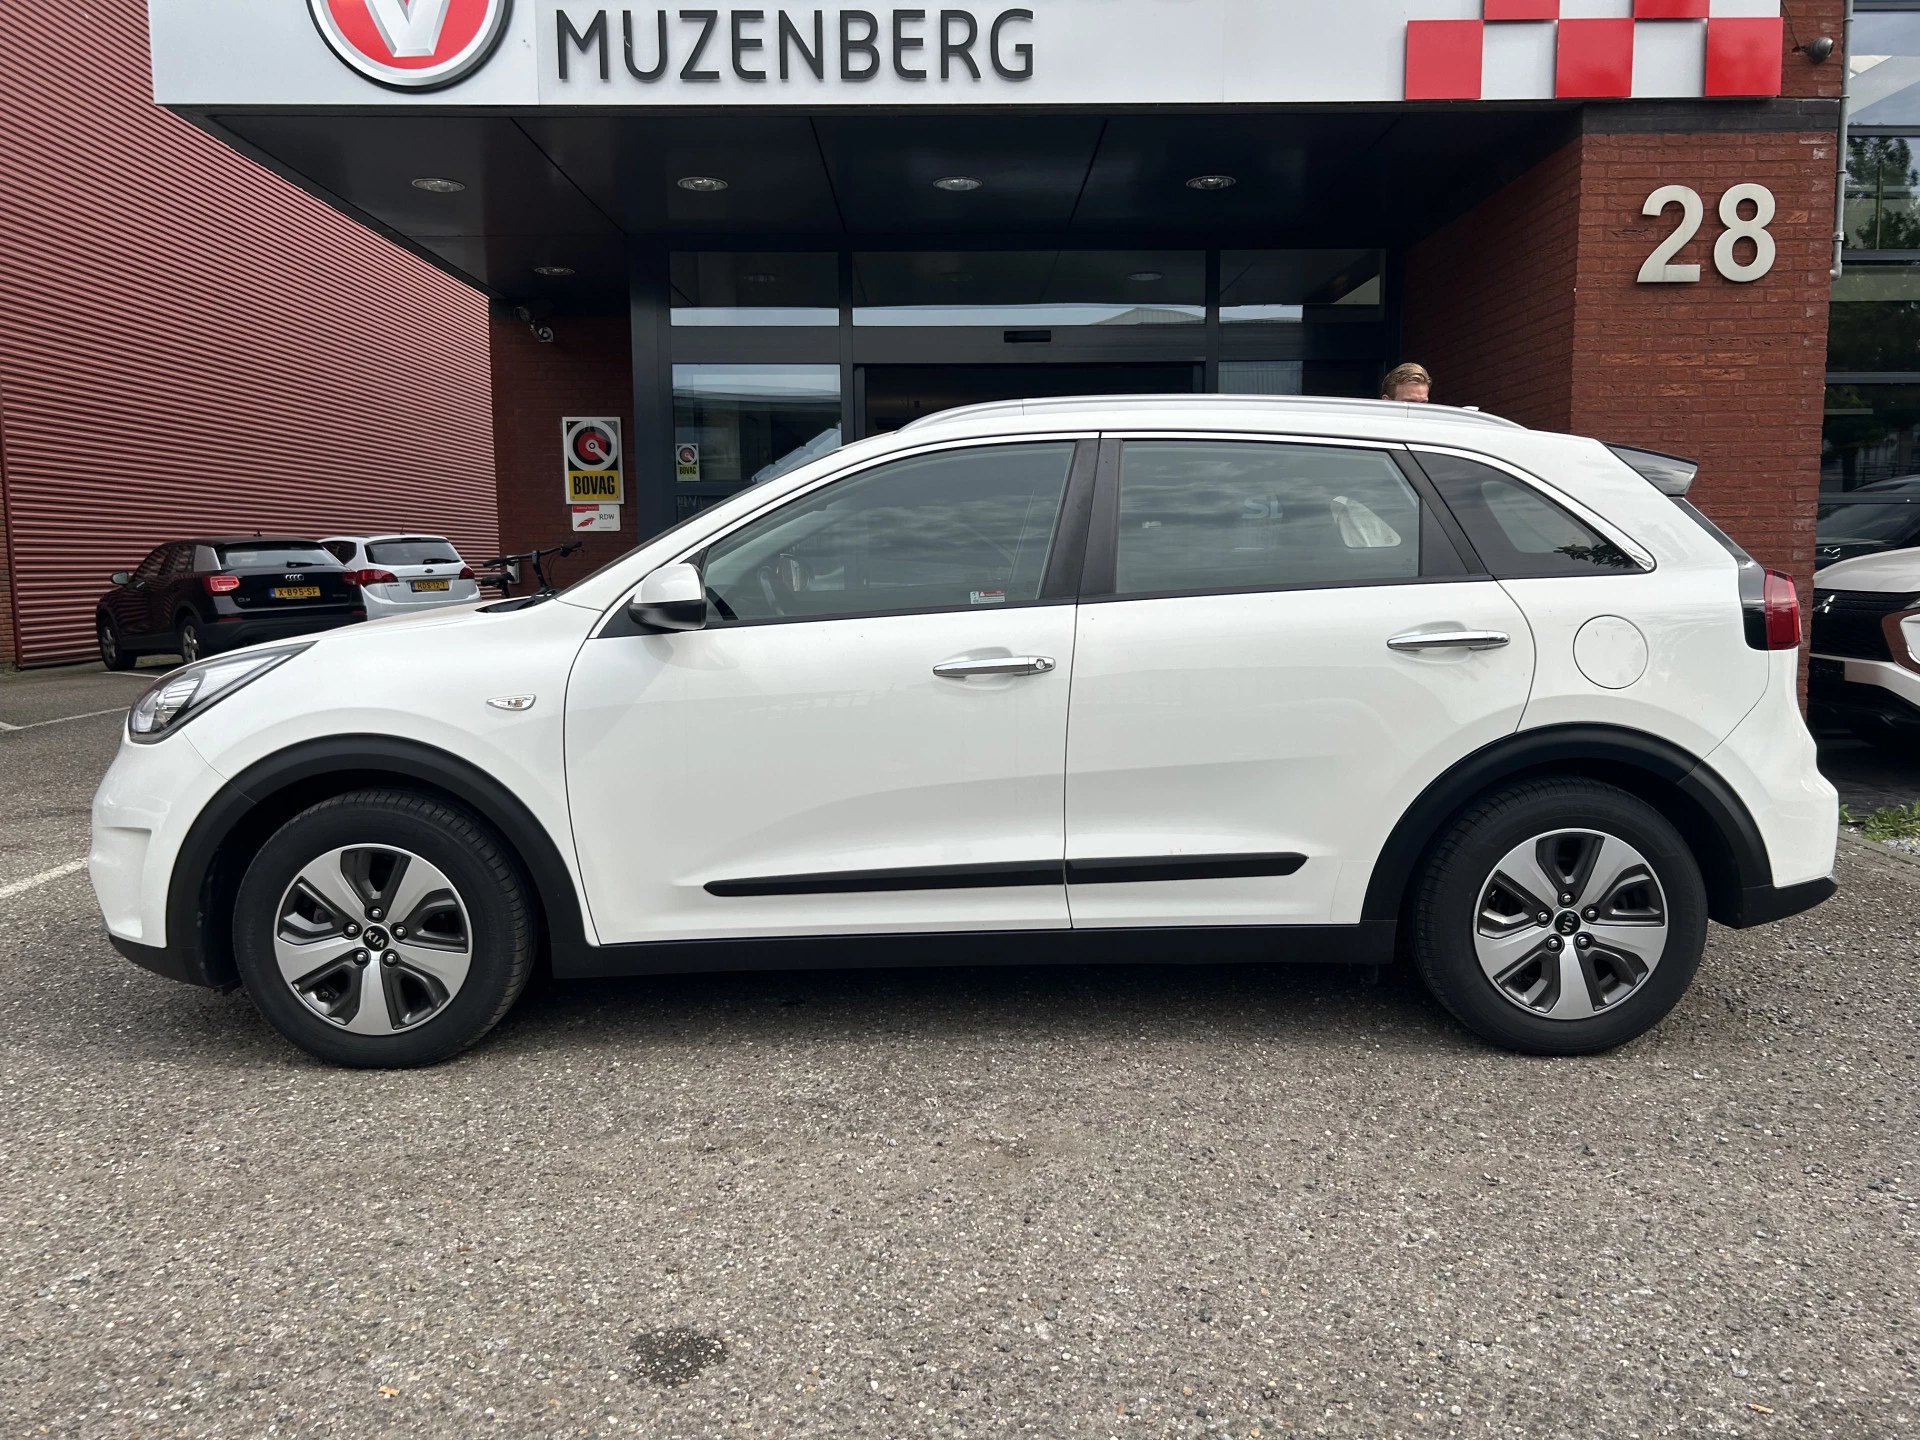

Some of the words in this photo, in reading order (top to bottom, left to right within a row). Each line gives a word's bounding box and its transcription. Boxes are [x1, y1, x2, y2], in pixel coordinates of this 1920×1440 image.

[556, 9, 1034, 82] MUZENBERG
[1637, 183, 1776, 283] 28
[679, 466, 697, 475] BOVAG
[573, 475, 616, 495] BOVAG
[278, 587, 318, 597] X-895-SF
[1561, 912, 1575, 933] KIA
[365, 929, 385, 948] KIA
